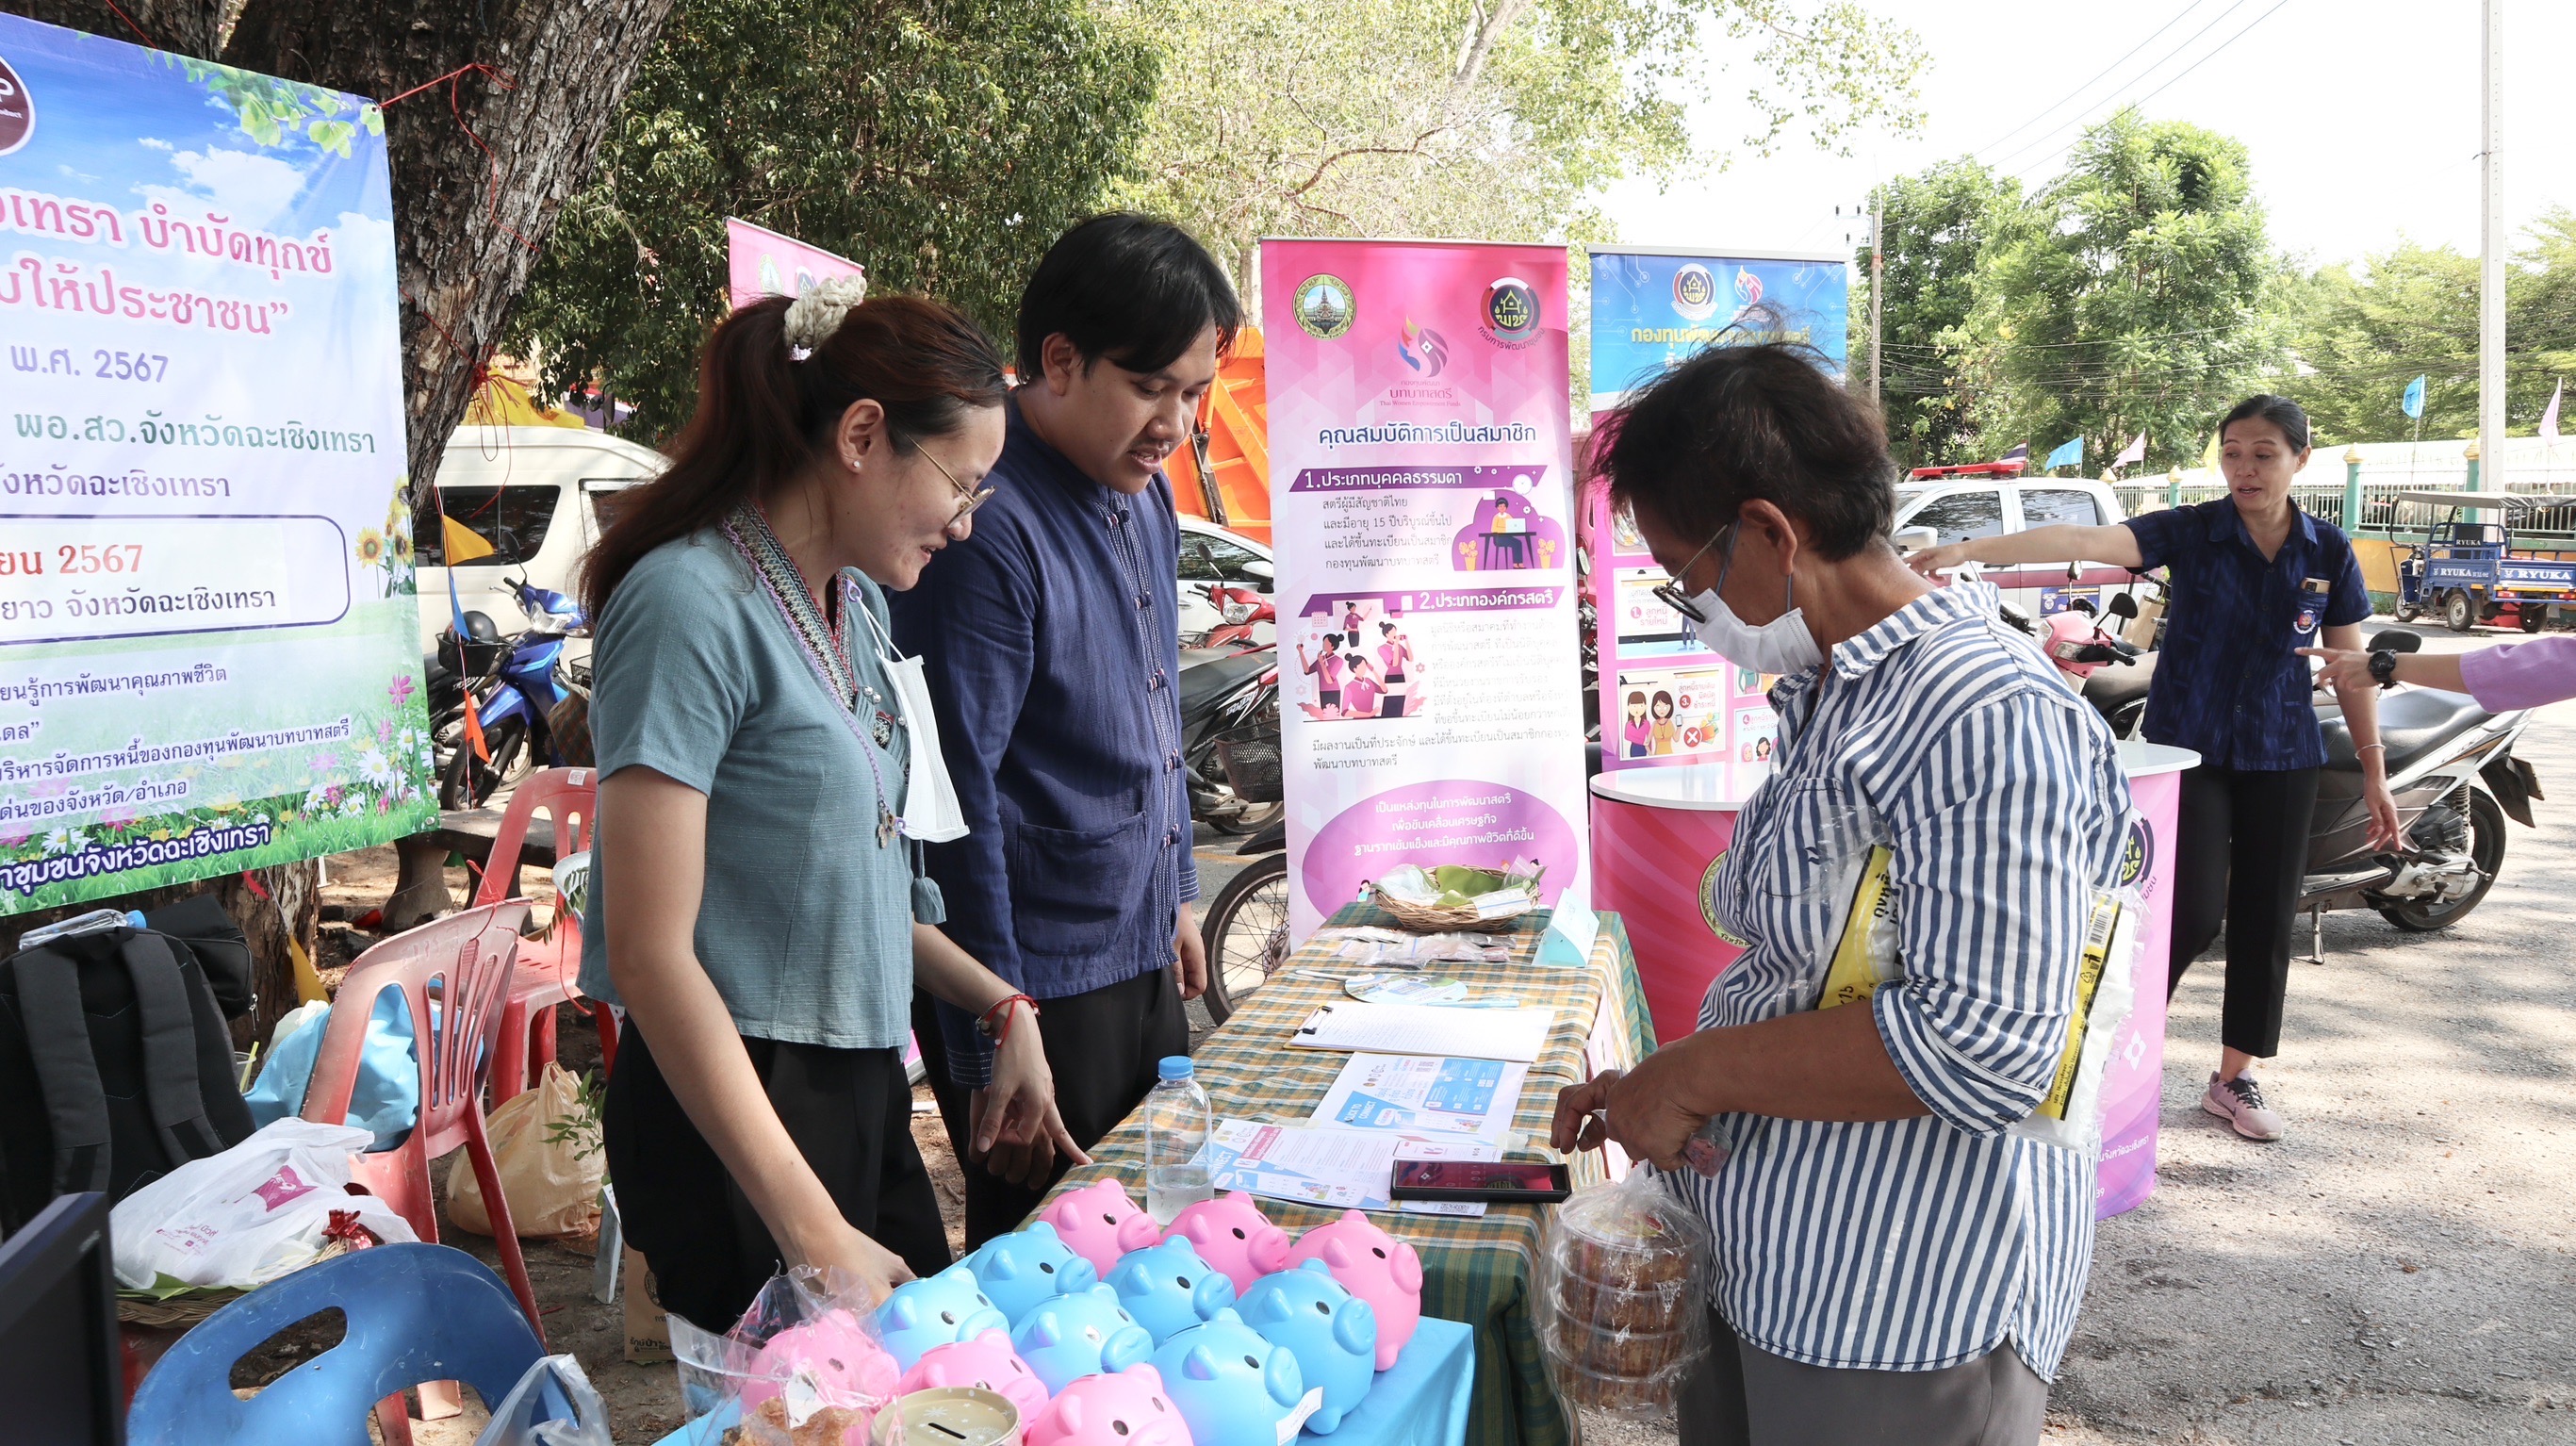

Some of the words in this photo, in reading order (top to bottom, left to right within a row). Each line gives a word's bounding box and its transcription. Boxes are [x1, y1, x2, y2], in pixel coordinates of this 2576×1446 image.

[139, 204, 332, 281] บำบัดทุกข์
[10, 344, 81, 375] พ.ศ.
[94, 349, 169, 383] 2567
[1389, 387, 1452, 399] บทบาทสตรี
[14, 410, 375, 453] พอ.สว.จังหวัดฉะเชิงเทรา
[1319, 421, 1536, 450] คุณสมบัติการเป็นสมาชิก
[0, 463, 231, 497] งหวัดฉะเชิงเทรา
[1305, 470, 1463, 488] 1.ประเภทบุคคลธรรมดา
[1322, 495, 1408, 513] สตรีผู้มีสัญชาติไทย
[1323, 518, 1370, 531] และมีอายุ
[1373, 518, 1386, 527] 15
[1388, 511, 1452, 530] ปีบริบูรณ์ขึ้นไป
[1324, 533, 1452, 550] และได้ขึ้นทะเบียนเป็นสมาชิก
[58, 545, 143, 573] 2567
[1325, 554, 1439, 571] กองทุนพัฒนาบทบาทสตรี
[2440, 568, 2472, 577] RYUKA
[2517, 570, 2572, 580] RYUKA
[1, 600, 54, 620] ยาว
[67, 586, 276, 617] จังหวัดฉะเชิงเทรา
[1419, 588, 1554, 610] 2.ประเภทองค์กรสตรี
[0, 721, 40, 741] ดล”
[0, 717, 349, 781] ริหารจัดการหนี้ของกองทุนพัฒนาบทบาทสตรี
[1312, 733, 1416, 751] มีผลงานเป็นที่ประจักษ์
[1313, 755, 1398, 770] พัฒนาบทบาทสตรี
[1375, 793, 1512, 813] เป็นแหล่งทุนในการพัฒนาสตรี
[1391, 813, 1497, 831] เพื่อขับเคลื่อนเศรษฐกิจ
[1354, 827, 1534, 857] ฐานรากเข้มแข็งและมีคุณภาพชีวิตที่ดีขึ้น
[2141, 876, 2158, 901] มชน
